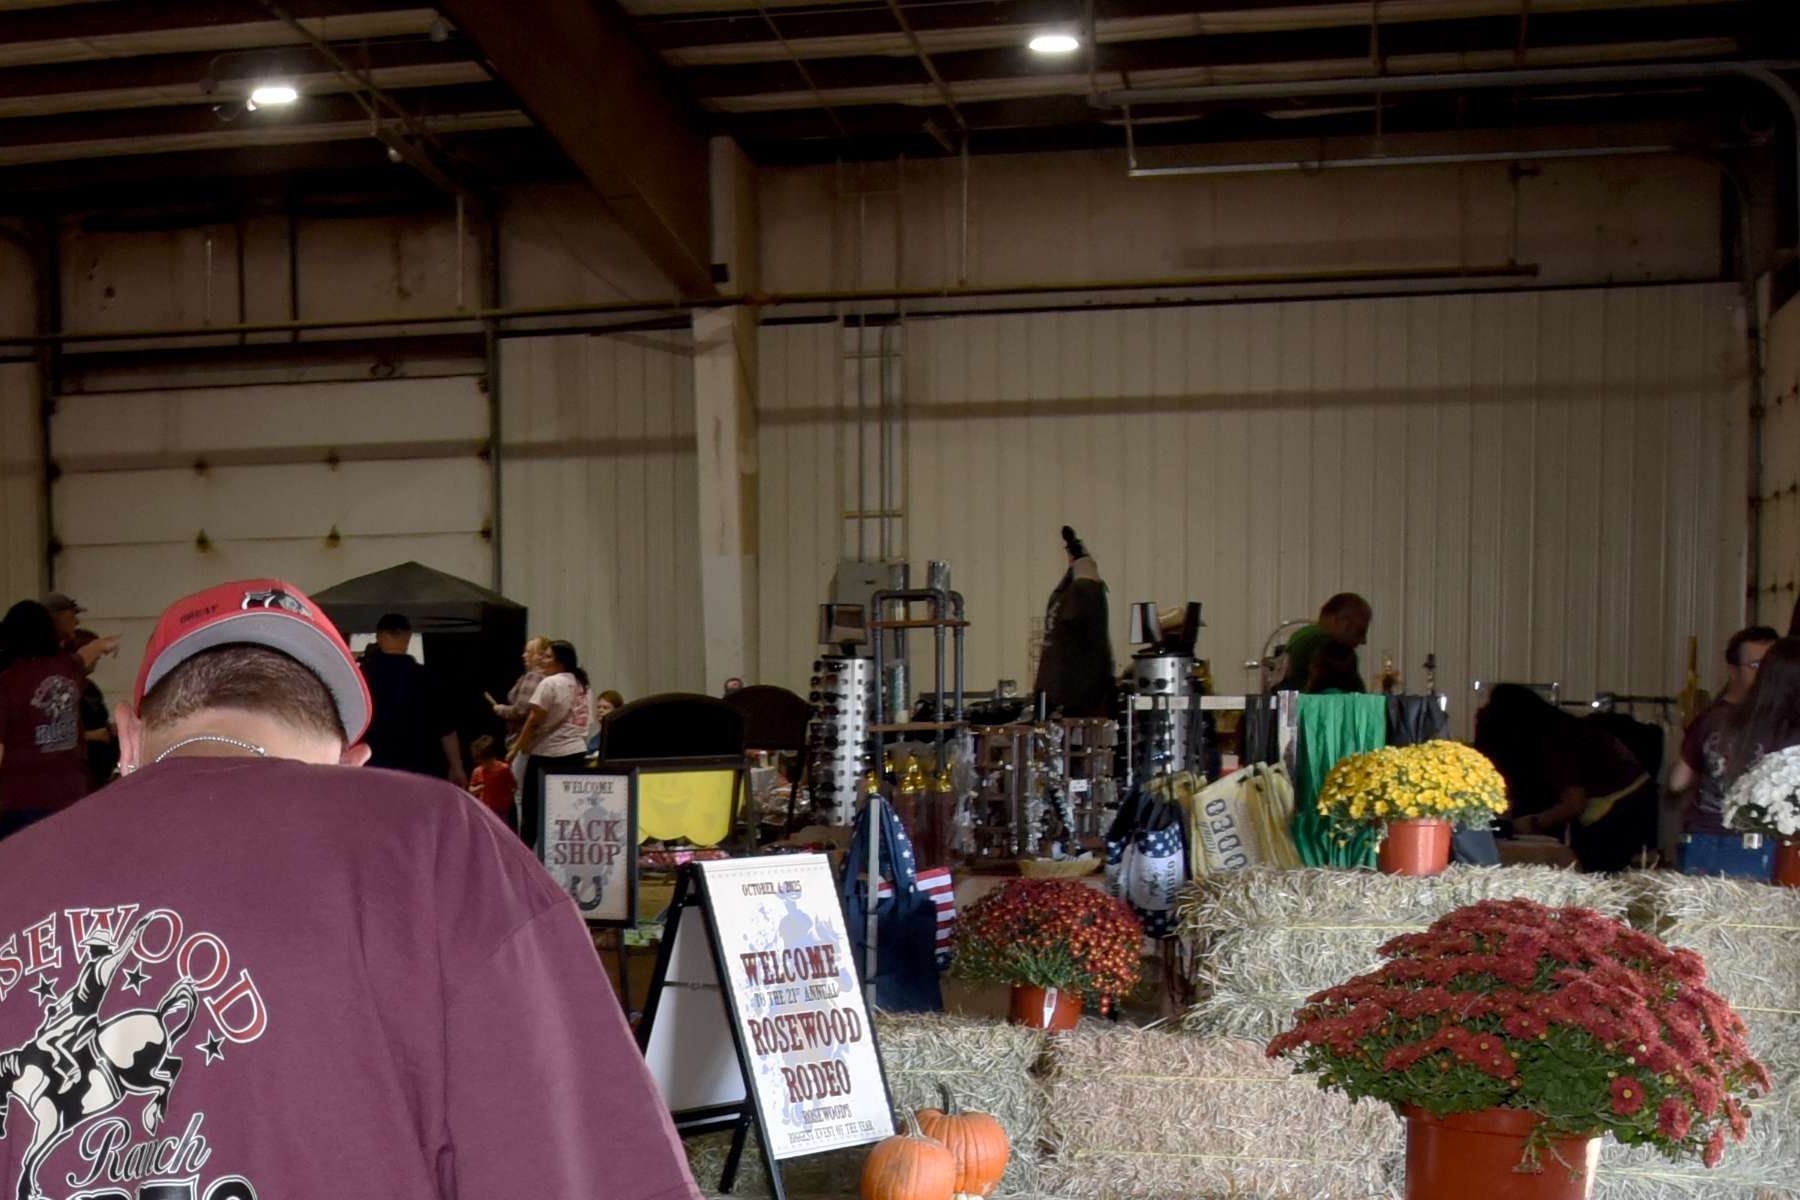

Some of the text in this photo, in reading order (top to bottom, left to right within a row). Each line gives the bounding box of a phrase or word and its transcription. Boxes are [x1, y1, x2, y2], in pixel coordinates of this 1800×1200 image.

[562, 780, 614, 794] WELCOME
[555, 819, 620, 842] TACK
[1204, 797, 1248, 872] ODEO
[554, 842, 620, 866] SHOP
[740, 944, 840, 987] WELCOME
[804, 982, 840, 1002] ANNUAL
[747, 1007, 862, 1056] ROSEWOOD
[781, 1059, 852, 1104] RODEO
